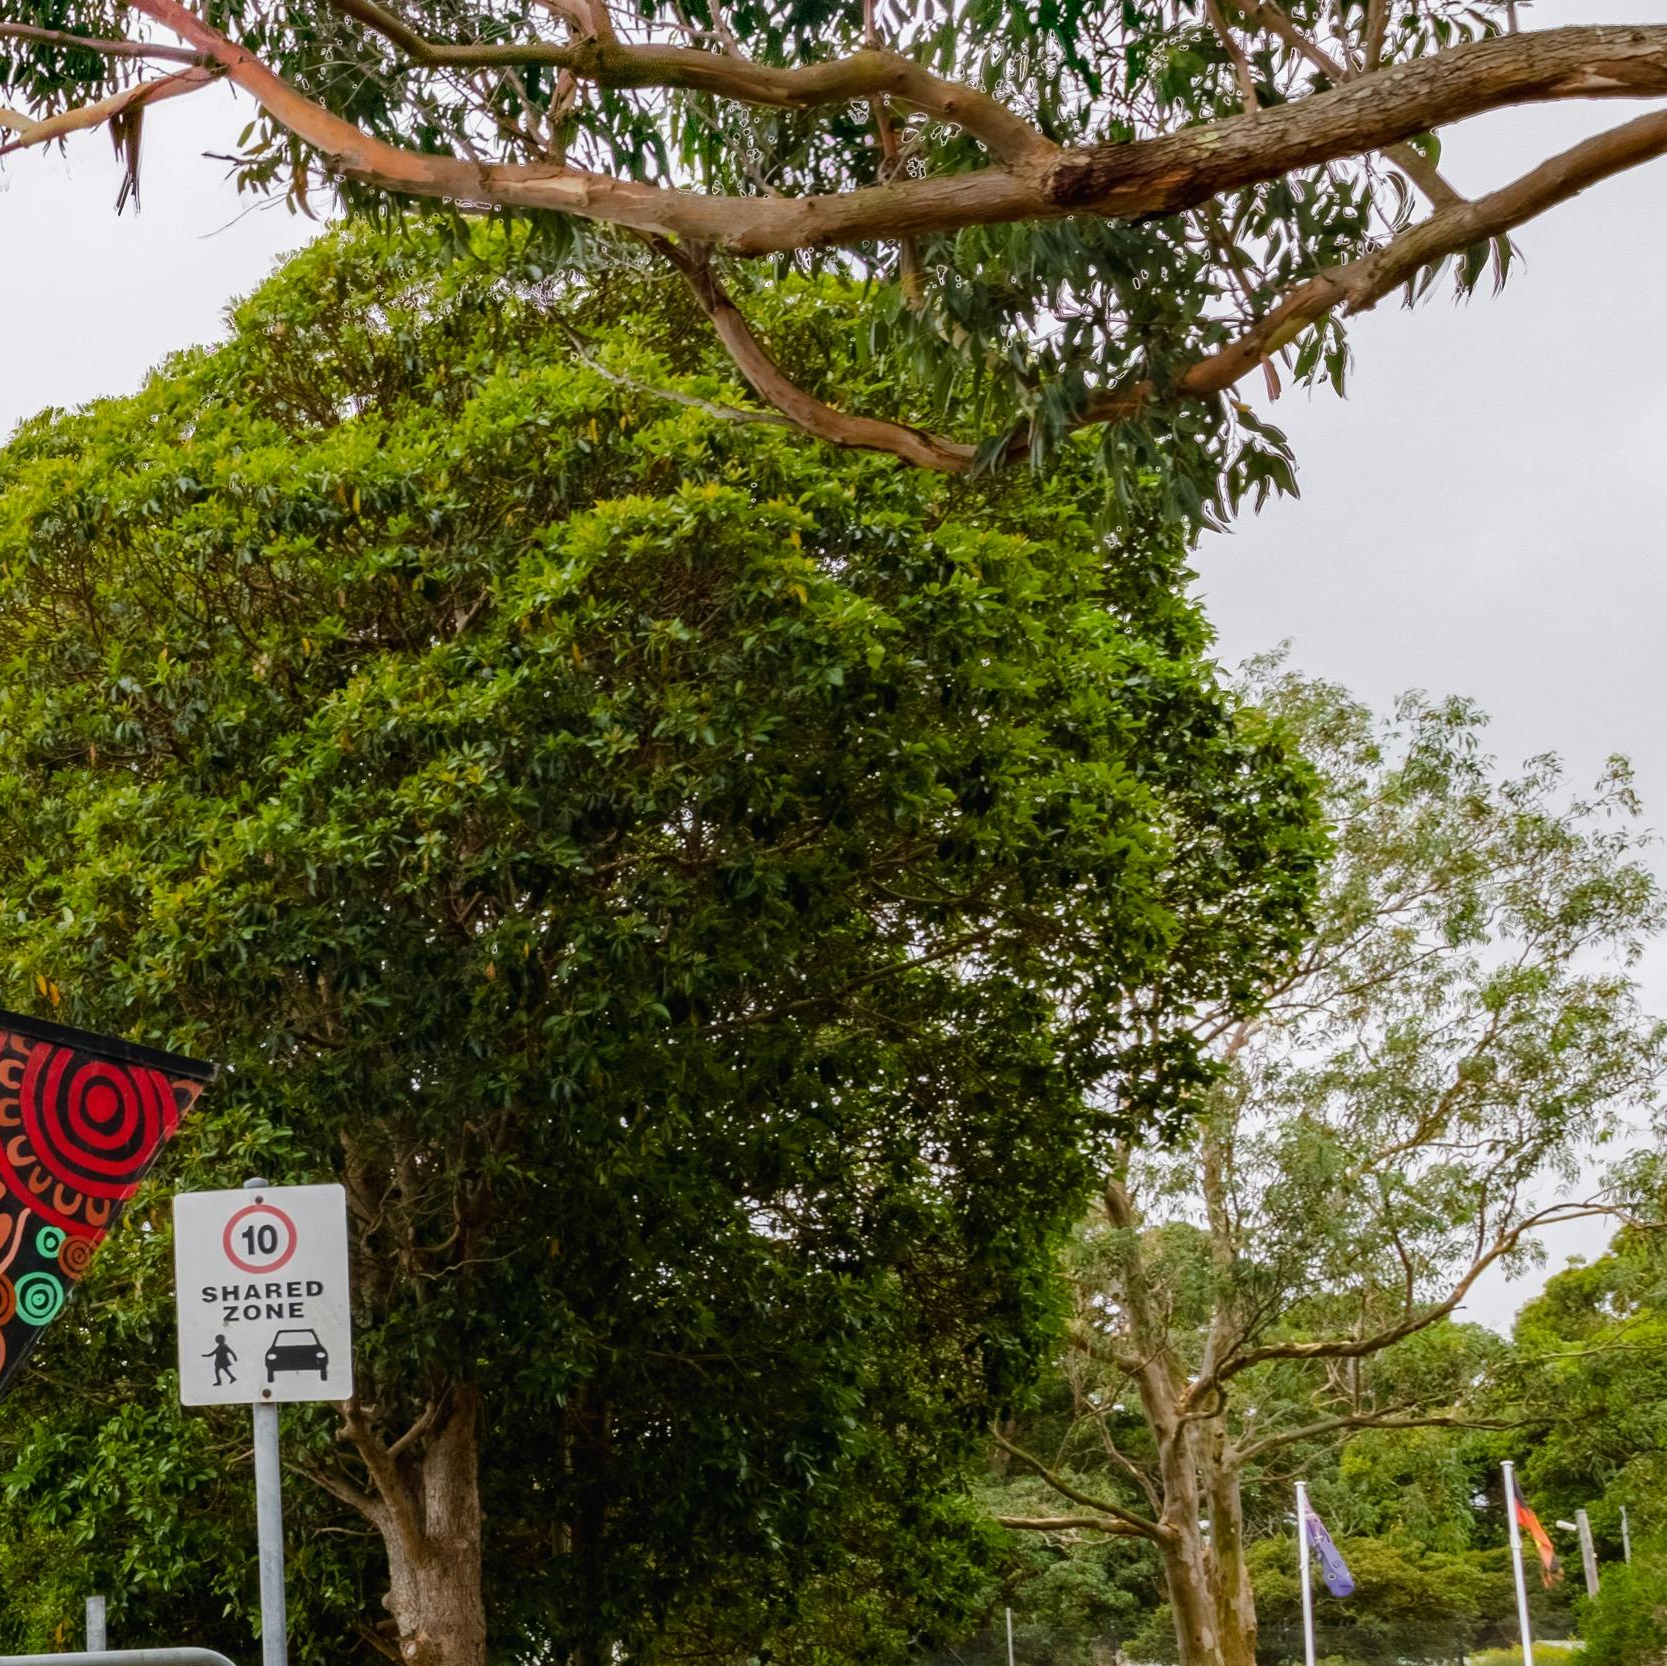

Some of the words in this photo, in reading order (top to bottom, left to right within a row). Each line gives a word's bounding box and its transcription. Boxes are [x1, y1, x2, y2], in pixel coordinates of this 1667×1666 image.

[241, 1224, 278, 1255] 10
[201, 1281, 324, 1303] SHARED
[223, 1302, 304, 1322] ZONE
